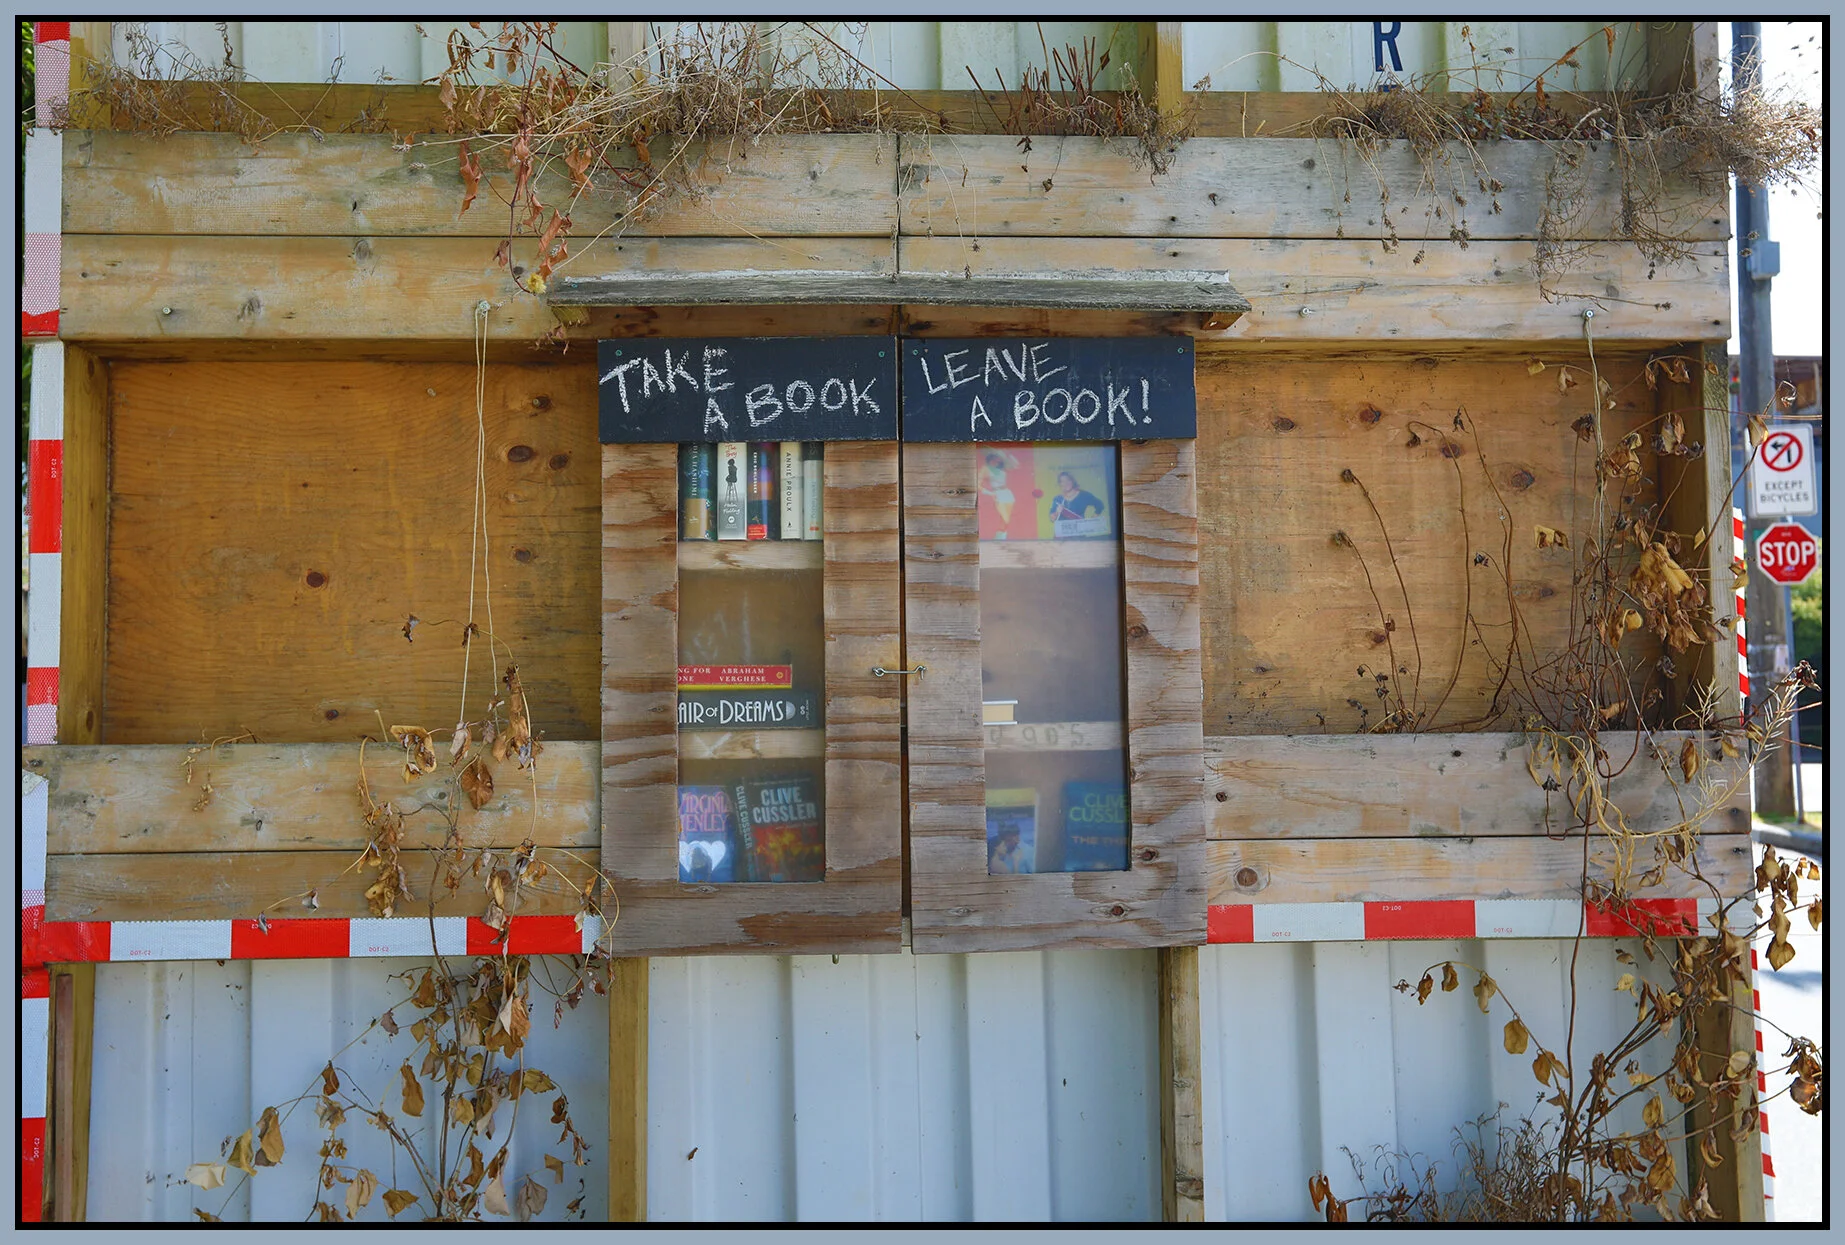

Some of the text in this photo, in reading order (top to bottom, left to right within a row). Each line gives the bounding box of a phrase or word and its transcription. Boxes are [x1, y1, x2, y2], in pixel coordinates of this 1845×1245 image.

[599, 345, 736, 414] TAKE
[920, 342, 1068, 395] LEAVE
[703, 377, 881, 434] A BOOK
[971, 376, 1153, 433] A BOOK!
[1760, 492, 1809, 503] BICYCLES
[1765, 480, 1803, 491] EXCEPT
[1761, 540, 1815, 567] STOP
[678, 701, 705, 724] AIR
[720, 699, 784, 725] DREAMS
[760, 786, 802, 806] CLIVE
[752, 802, 817, 824] CUSSLER
